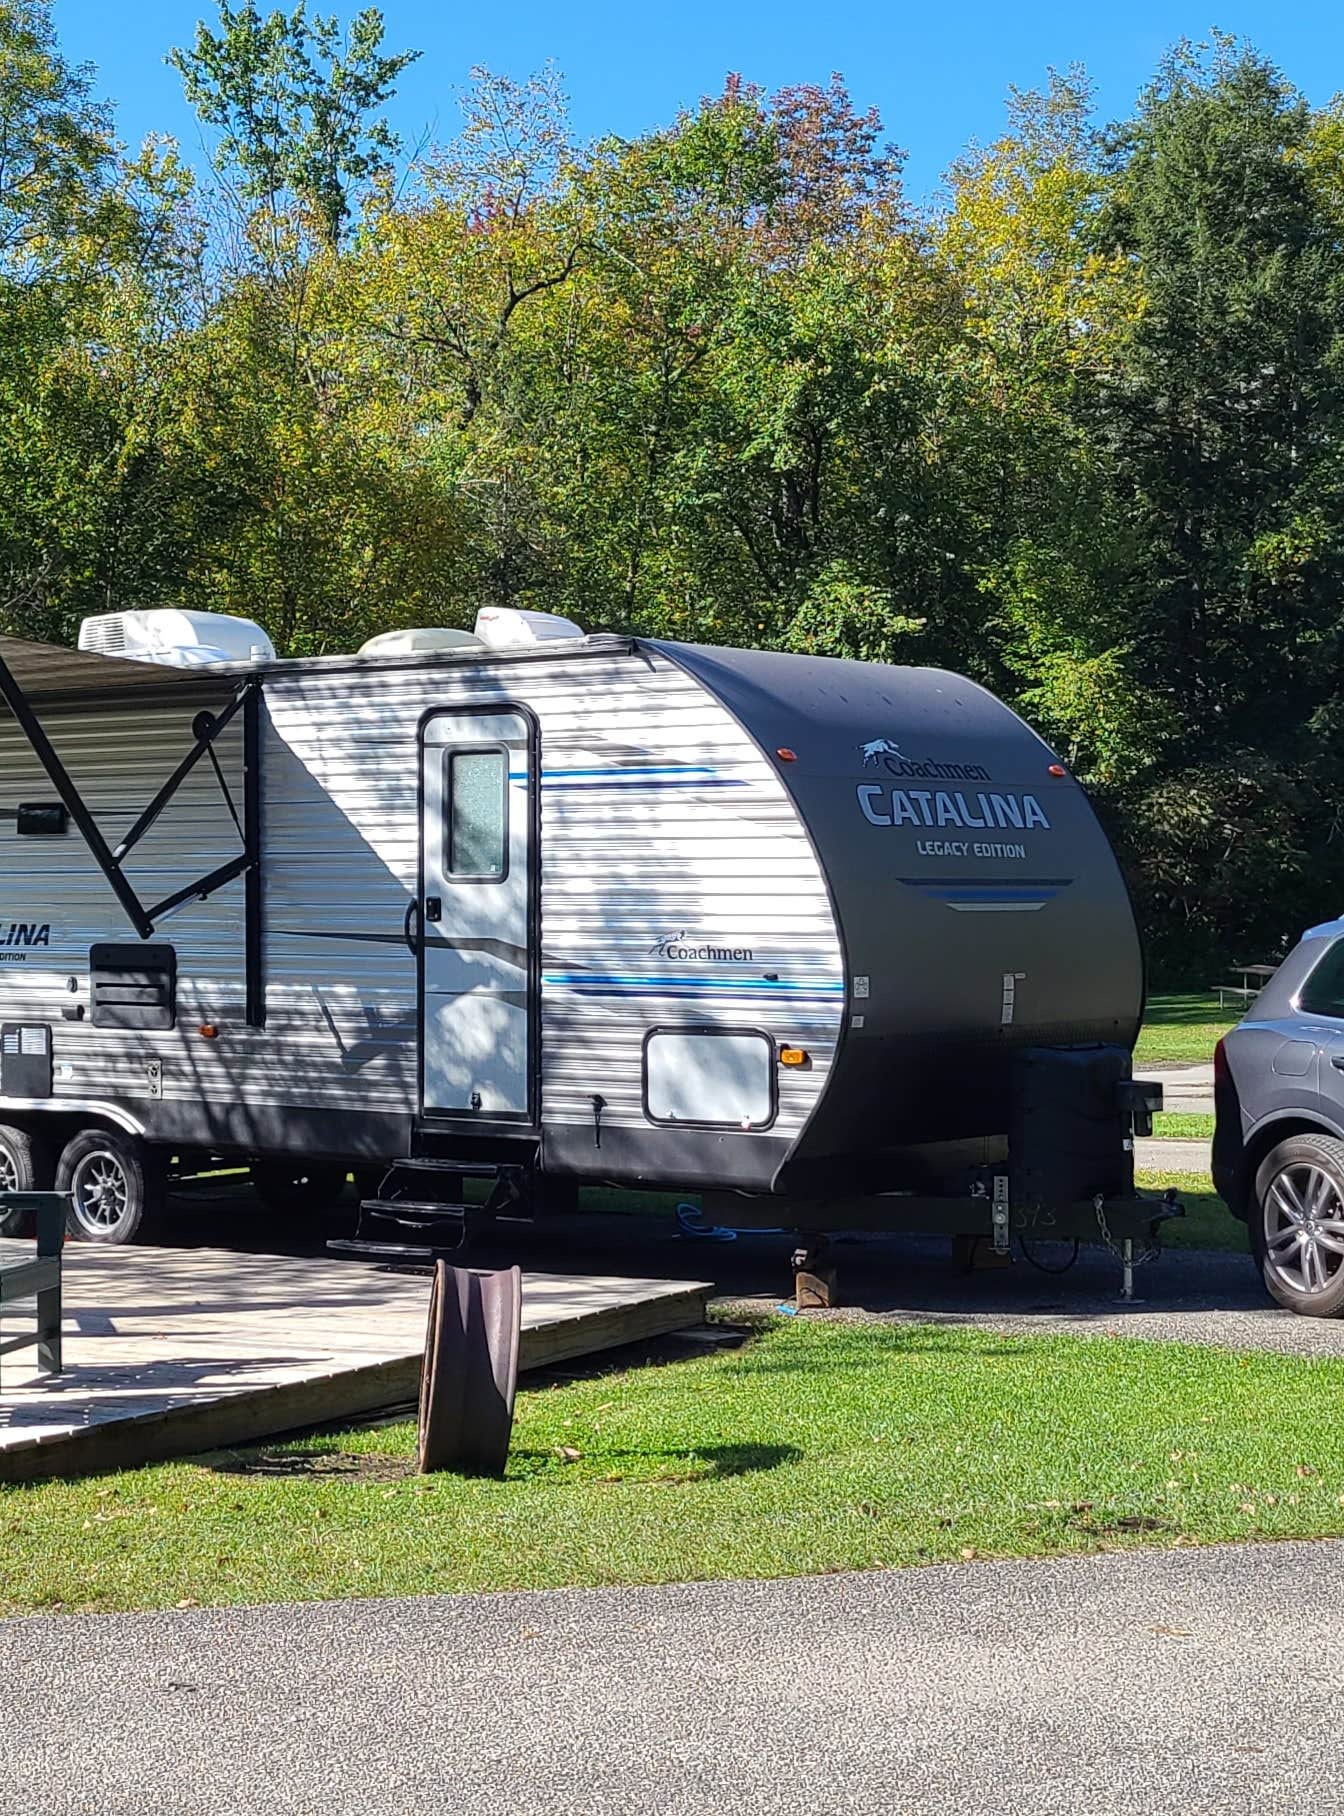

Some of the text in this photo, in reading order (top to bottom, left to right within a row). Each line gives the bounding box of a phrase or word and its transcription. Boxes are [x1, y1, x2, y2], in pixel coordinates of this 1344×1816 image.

[884, 757, 991, 781] Coachmen
[856, 784, 1051, 829] CATALINA
[917, 840, 1026, 859] LEGACY EDITION
[666, 944, 753, 961] Coachmen
